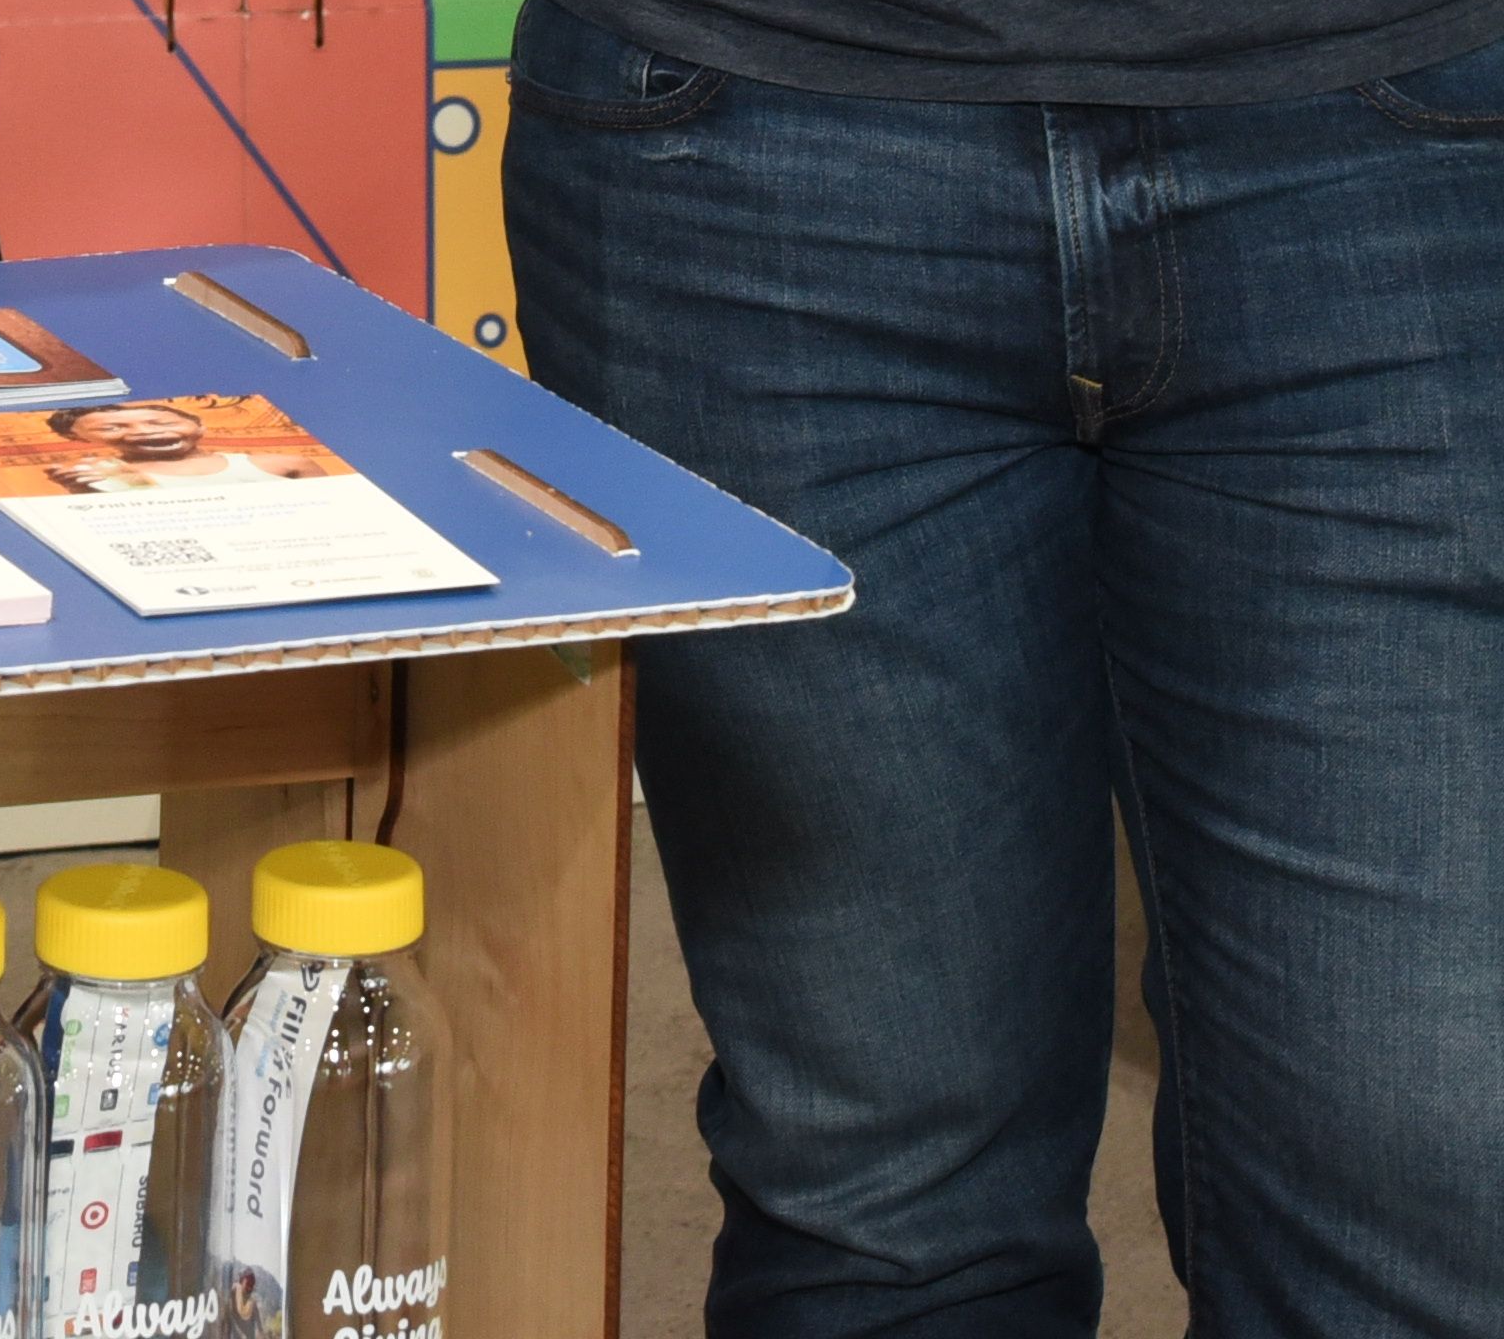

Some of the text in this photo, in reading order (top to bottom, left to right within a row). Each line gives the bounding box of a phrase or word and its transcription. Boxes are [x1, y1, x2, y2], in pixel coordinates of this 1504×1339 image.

[247, 995, 309, 1219] Fill Forward
[73, 1288, 220, 1338] Always
[321, 1254, 447, 1316] Always
